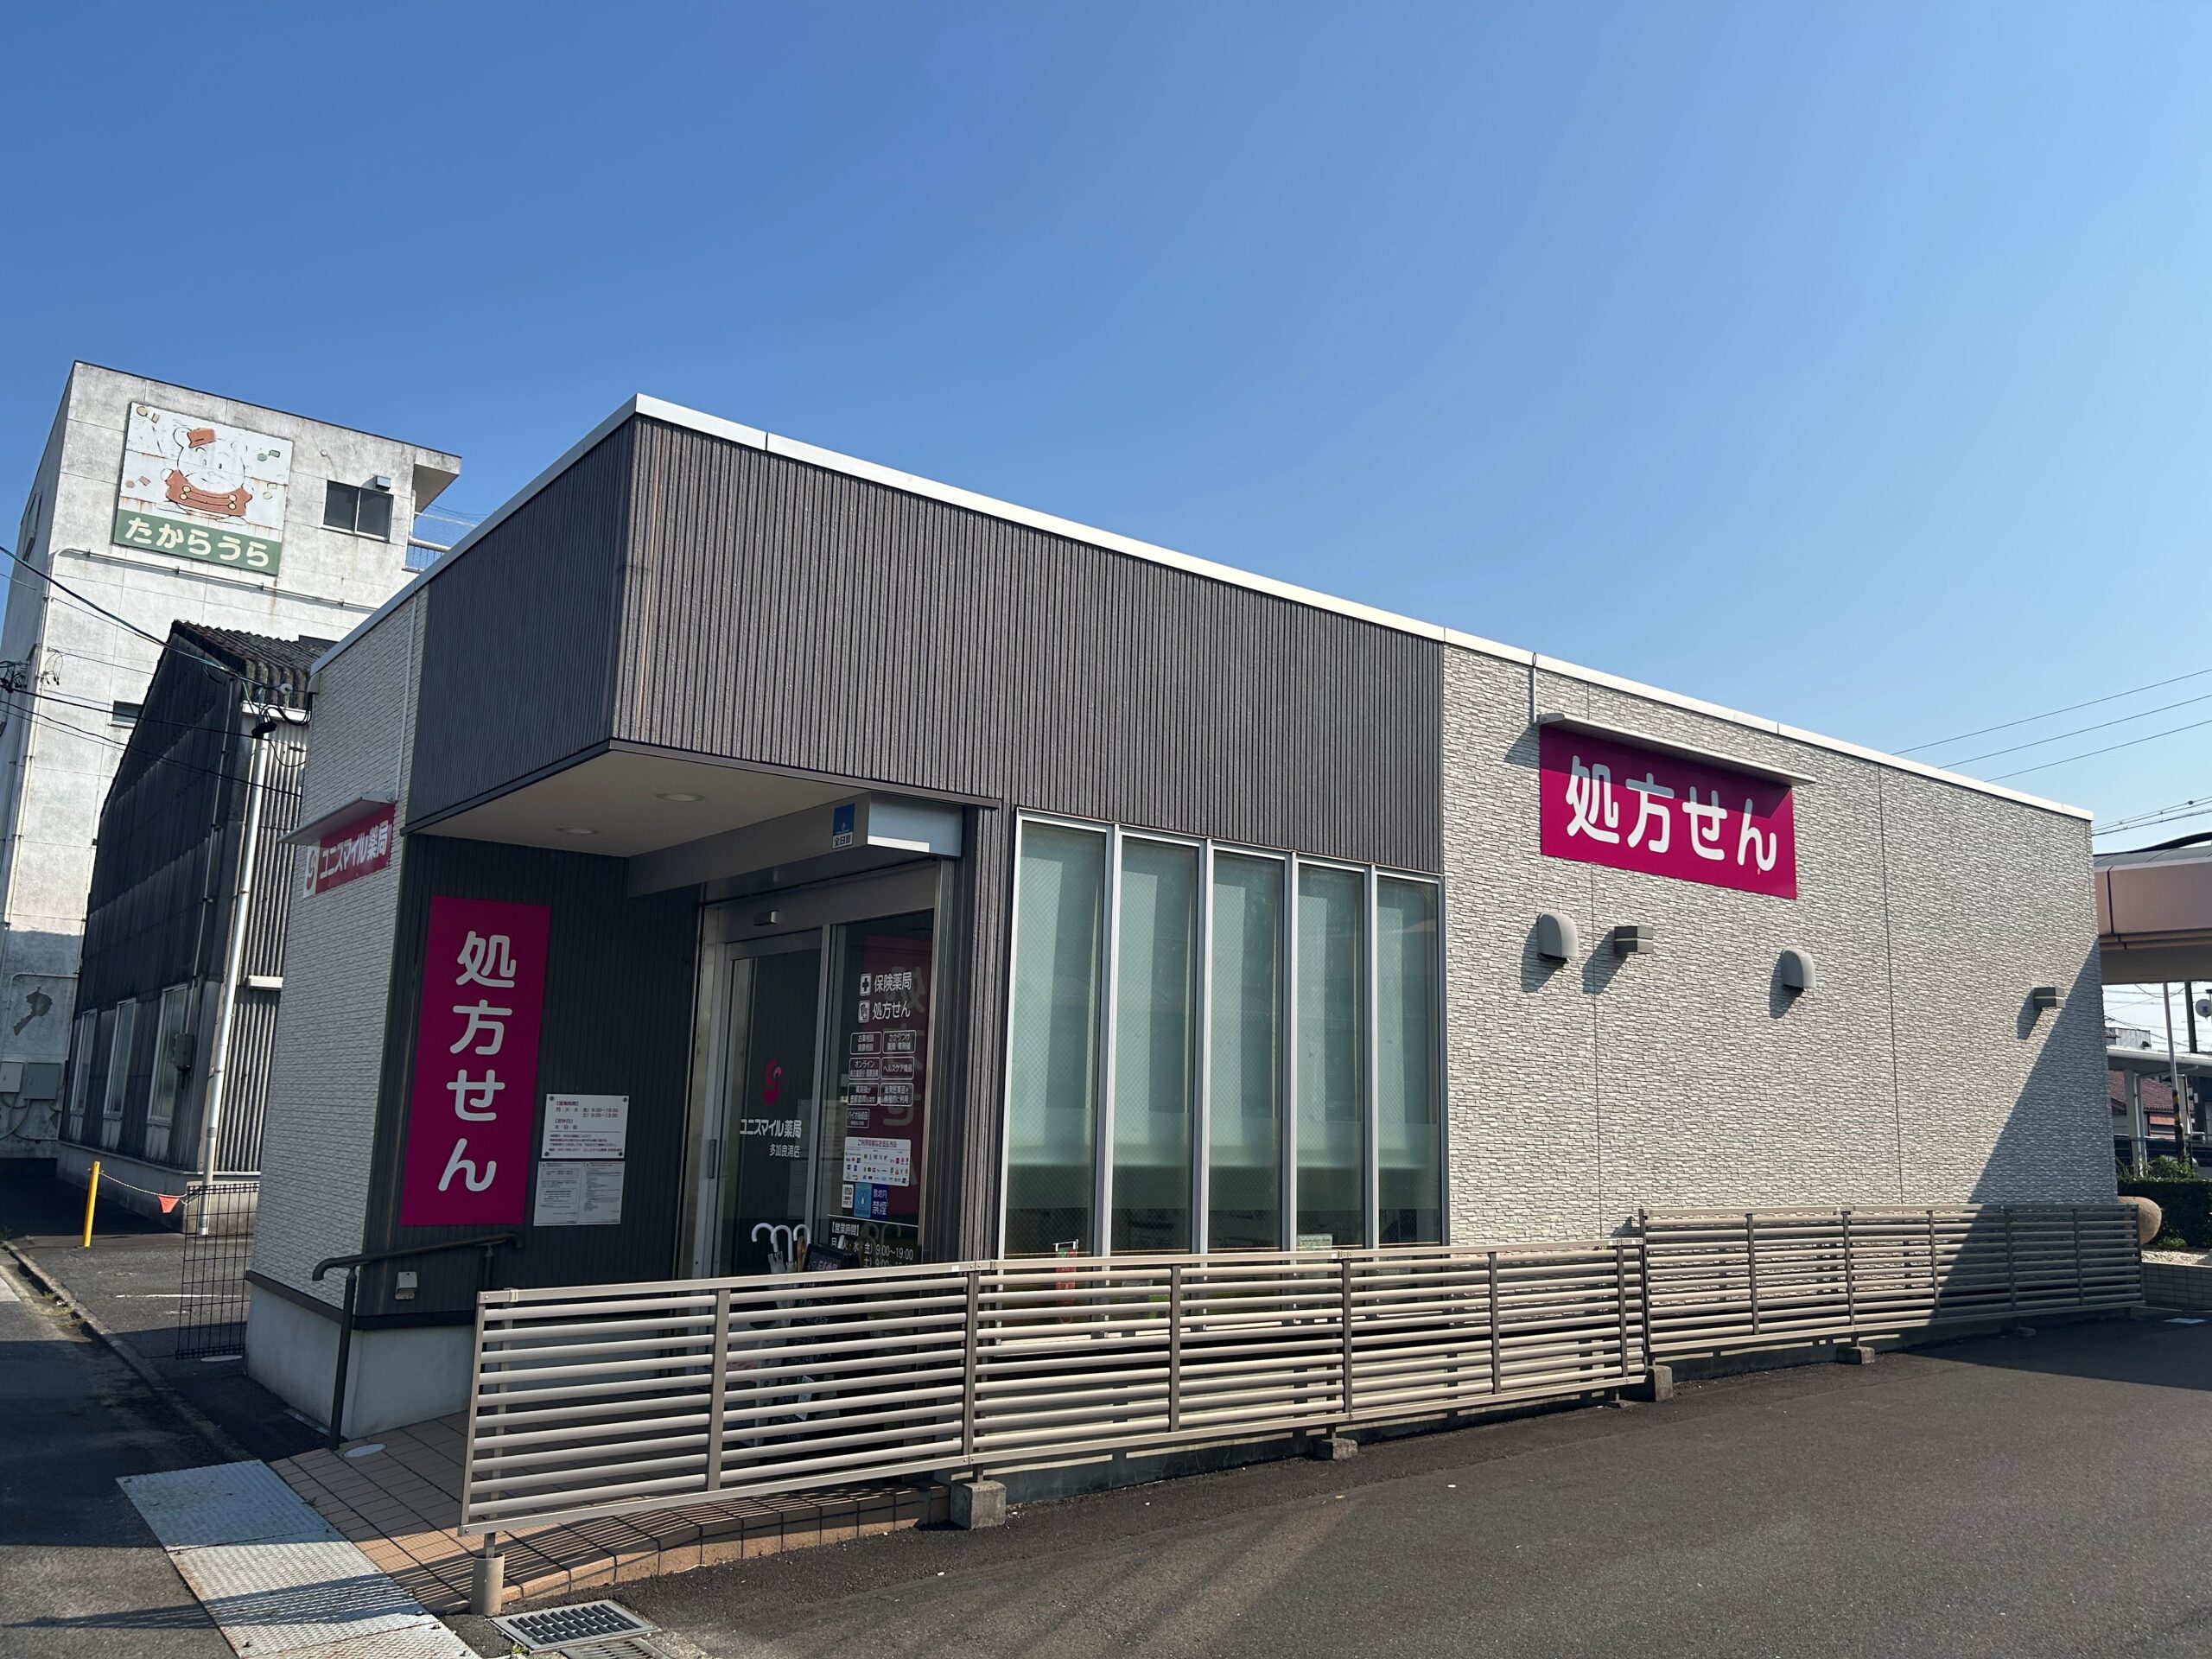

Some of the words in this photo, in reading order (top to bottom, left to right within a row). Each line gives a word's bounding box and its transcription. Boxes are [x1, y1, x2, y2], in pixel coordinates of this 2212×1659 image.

[124, 517, 270, 569] たからうら
[1565, 754, 1778, 872] 処方せん
[320, 820, 389, 879] ユニスマイル薬局
[874, 972, 912, 993] 保険薬局
[873, 1001, 911, 1020] 処方せん
[438, 930, 517, 1192] 処方せん
[855, 1060, 874, 1069] オンライン
[883, 1065, 912, 1073] ヘルスケア商品
[740, 1119, 802, 1139] ユニスマイル薬局
[872, 1200, 887, 1216] 禁煙
